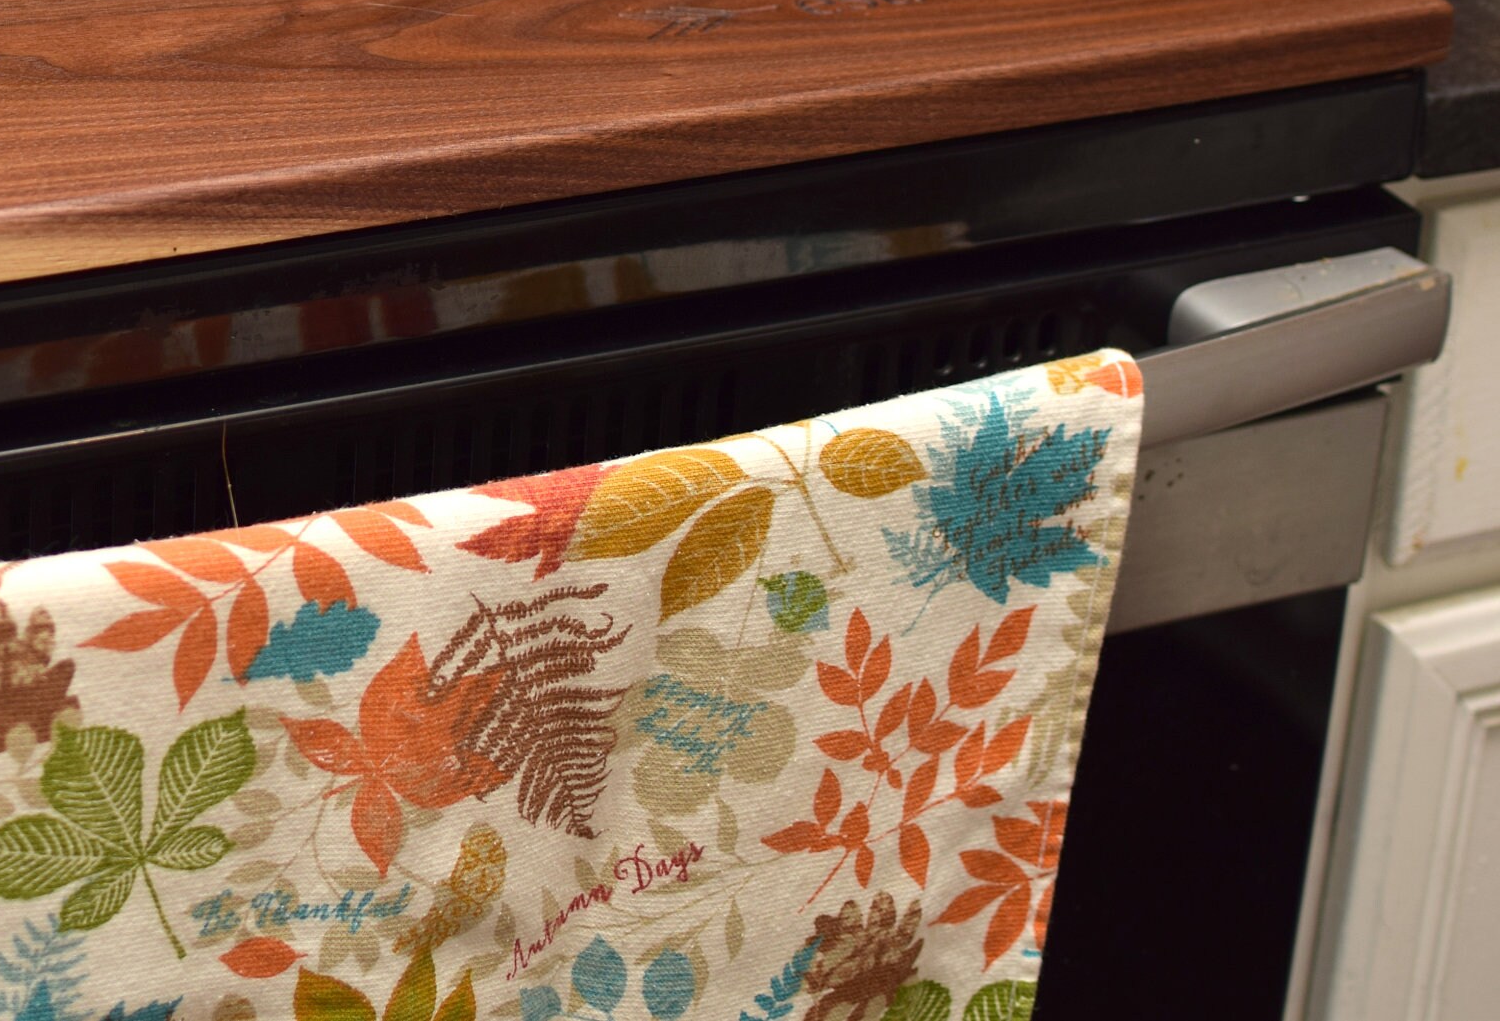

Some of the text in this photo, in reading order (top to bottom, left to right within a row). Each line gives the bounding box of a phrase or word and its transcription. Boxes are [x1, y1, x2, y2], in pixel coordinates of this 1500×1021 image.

[190, 882, 412, 937] Be Thankful
[506, 840, 708, 981] Autumn Days
